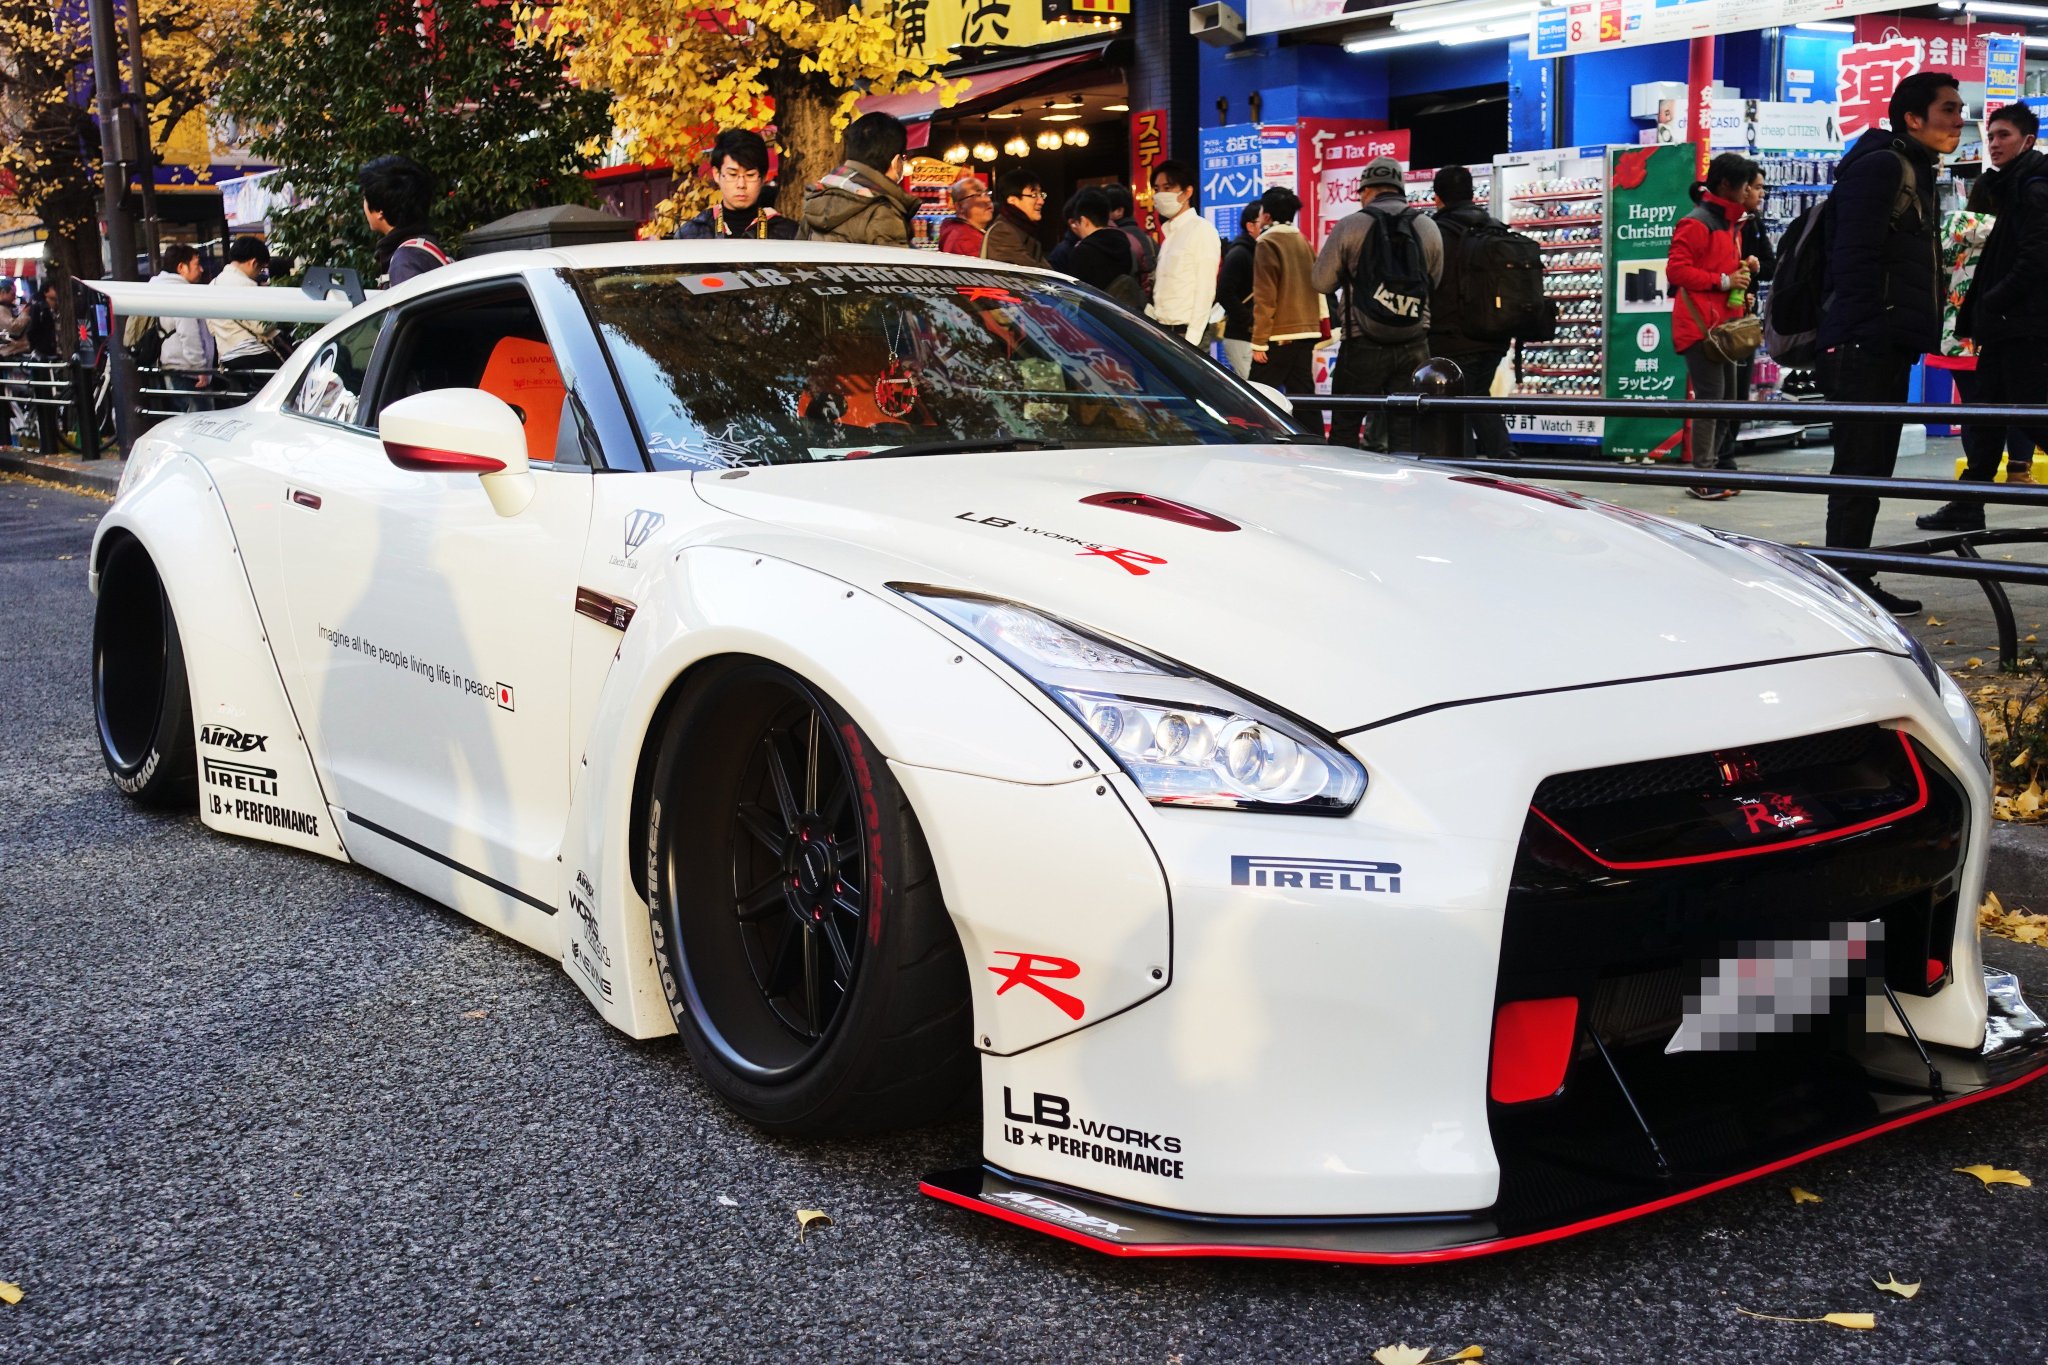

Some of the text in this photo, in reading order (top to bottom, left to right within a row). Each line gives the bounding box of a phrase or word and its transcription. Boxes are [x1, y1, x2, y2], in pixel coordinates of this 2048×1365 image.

[1711, 117, 1740, 128] CASIO
[1761, 125, 1820, 137] cheap CITIZEN
[1345, 142, 1395, 159] Tax Free
[1361, 166, 1403, 180] IGN
[1629, 204, 1676, 222] Happy
[1617, 223, 1674, 240] Christm
[738, 268, 792, 288] LB
[1618, 376, 1676, 392] ラッピング
[1541, 420, 1572, 433] Watch
[318, 622, 496, 700] Imagine all the people living life in peace
[203, 756, 278, 797] PIRELLI
[209, 793, 320, 837] LB PERFORMANCE
[1231, 855, 1402, 893] PIRELLI
[650, 919, 686, 1025] TOYO
[1004, 1123, 1184, 1180] LB PERFORMANCE
